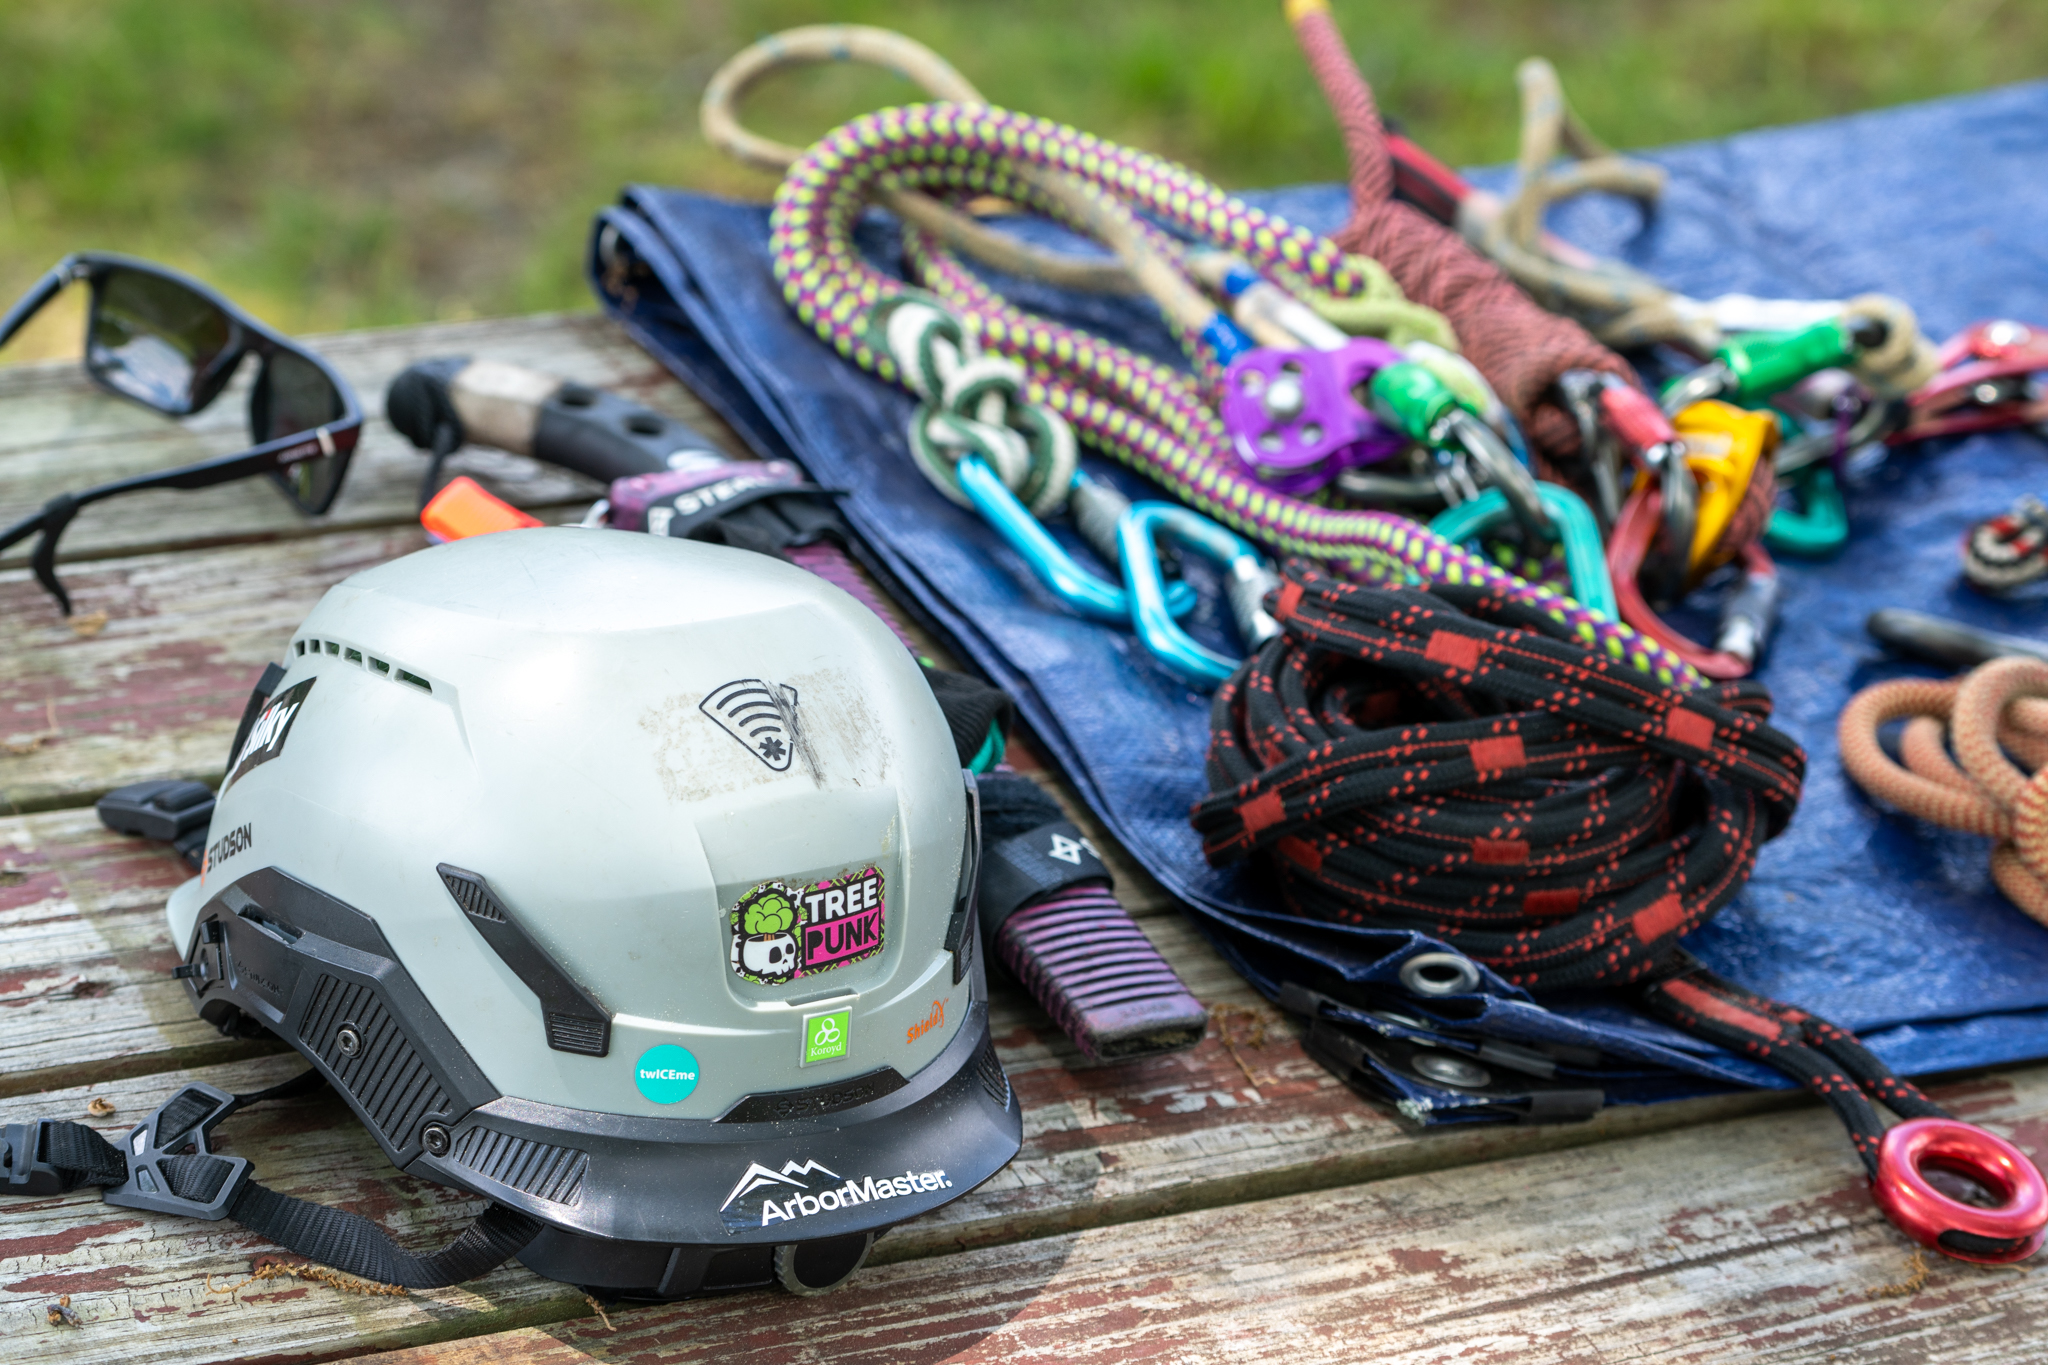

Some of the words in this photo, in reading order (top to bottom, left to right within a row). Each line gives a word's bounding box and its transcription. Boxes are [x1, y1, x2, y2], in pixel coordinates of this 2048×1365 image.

[207, 822, 252, 874] STUDSON
[805, 877, 877, 923] TREE
[807, 912, 878, 960] PUNK
[810, 1042, 842, 1057] Koroyd
[640, 1068, 696, 1081] twICEme
